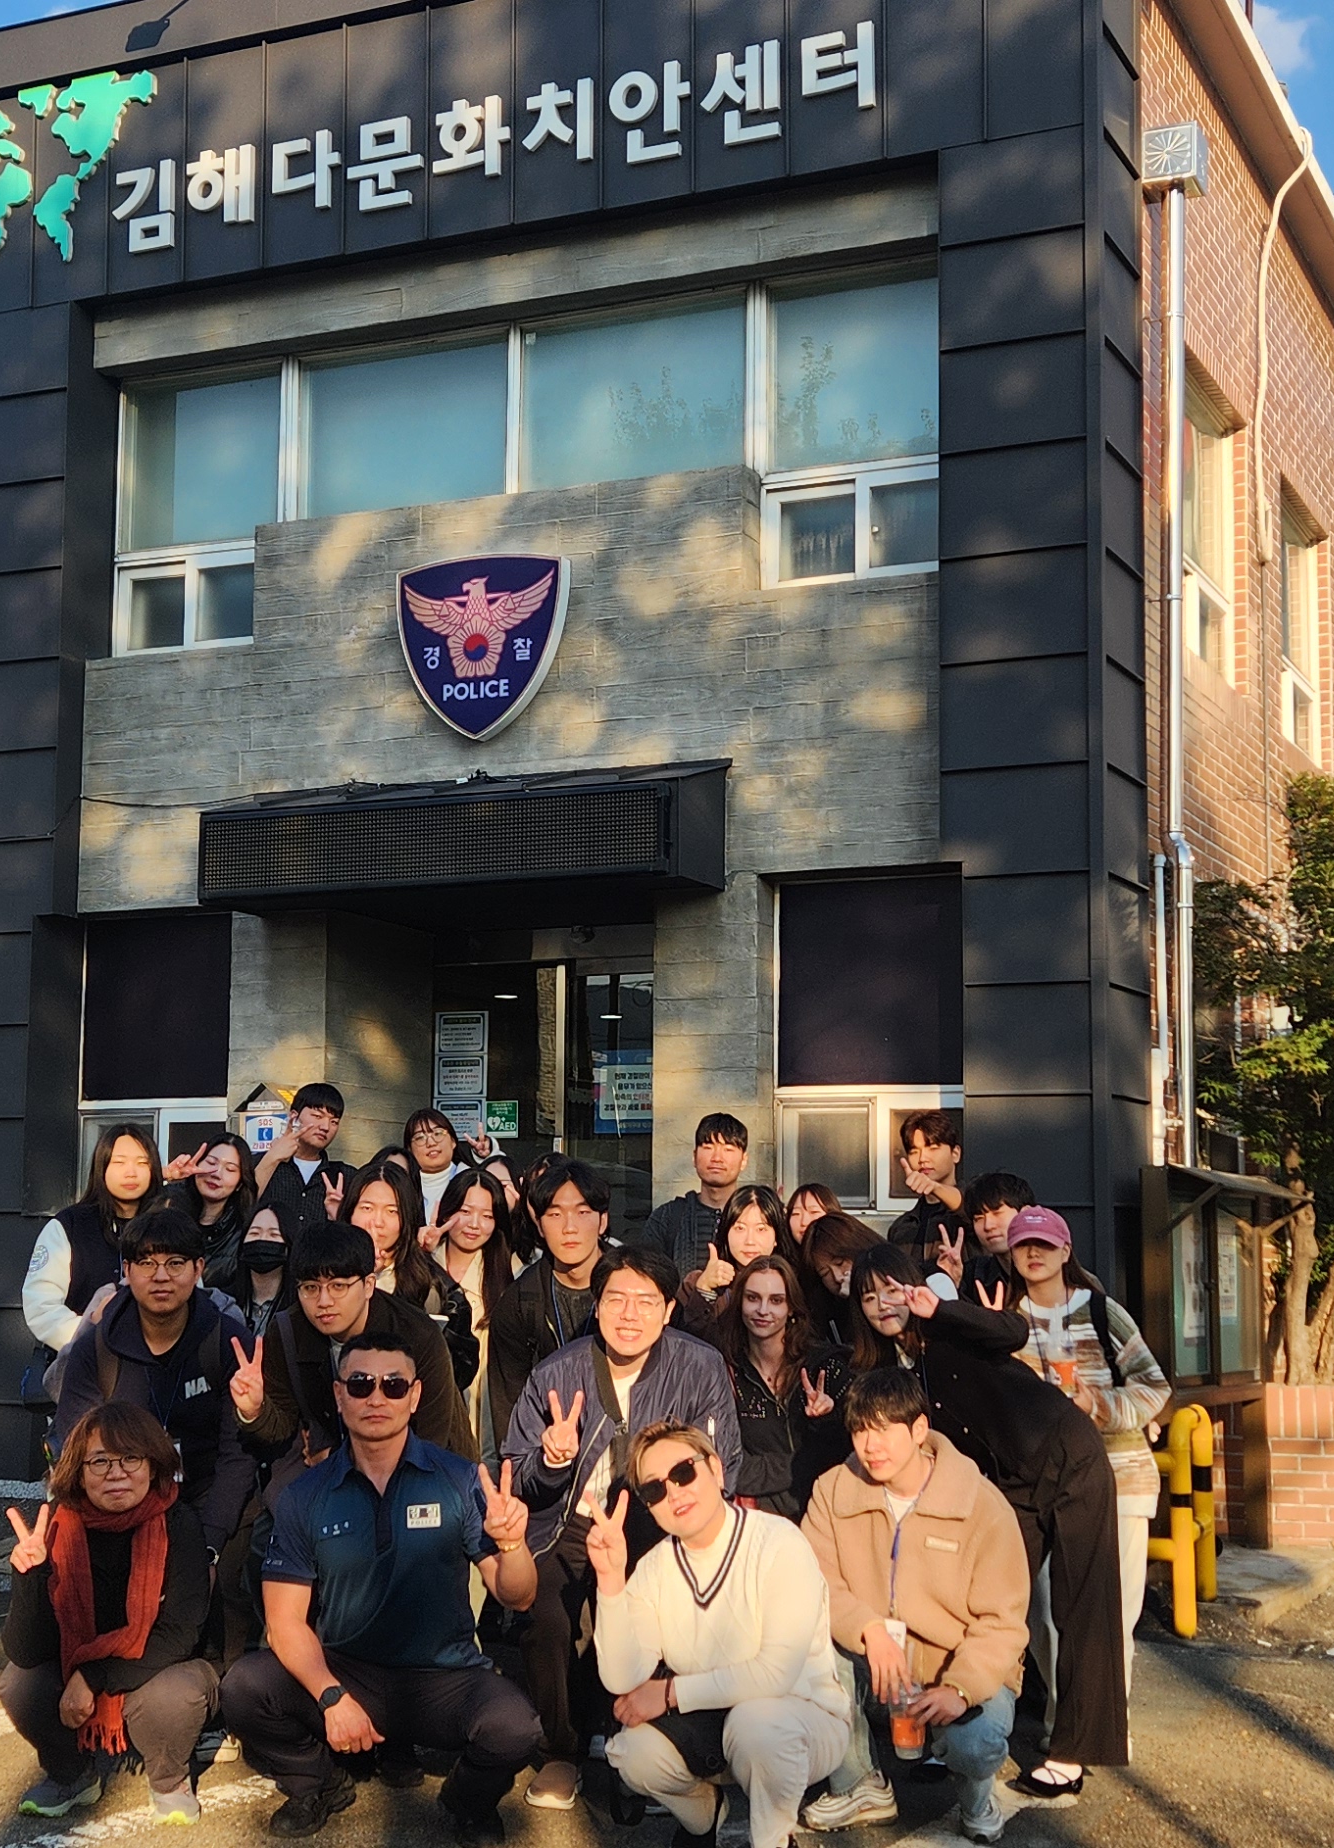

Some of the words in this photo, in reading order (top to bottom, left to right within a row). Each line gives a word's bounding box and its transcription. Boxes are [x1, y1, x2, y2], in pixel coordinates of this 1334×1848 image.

[112, 20, 876, 253] 김해다문화치안센터
[423, 646, 442, 670] 경
[512, 637, 533, 661] 찰
[442, 678, 510, 702] POLICE
[257, 1118, 274, 1127] SOS
[498, 1121, 516, 1131] AED
